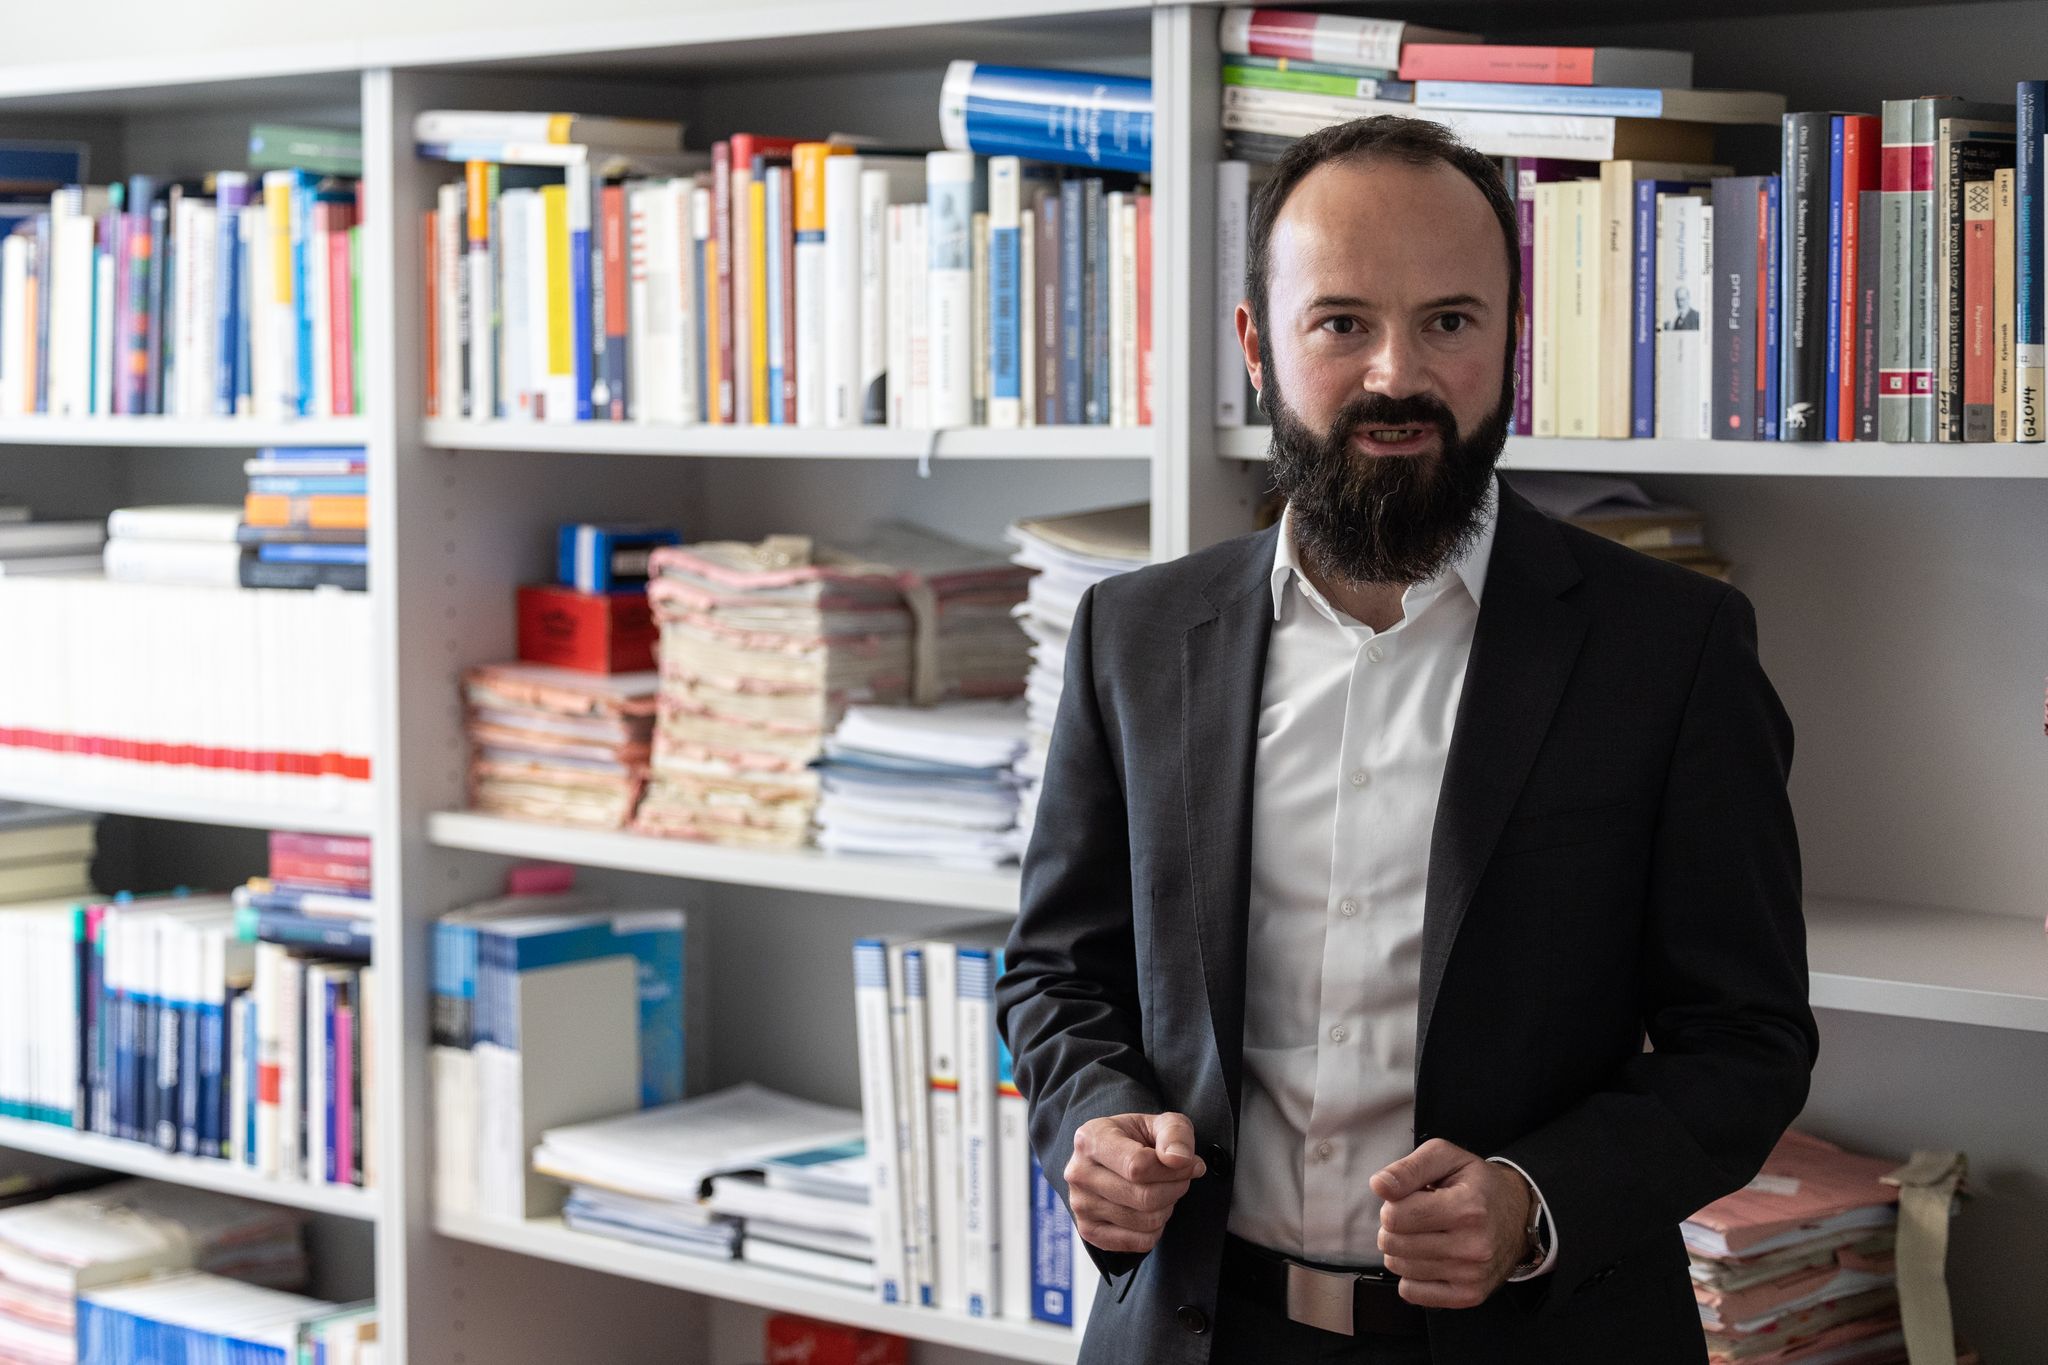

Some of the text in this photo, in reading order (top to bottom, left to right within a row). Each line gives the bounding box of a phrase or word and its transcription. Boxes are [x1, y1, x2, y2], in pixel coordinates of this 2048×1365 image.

[1799, 126, 1809, 145] Otto
[1796, 153, 1809, 192] Kernberg
[1701, 217, 1713, 276] Sigmund Freud
[2021, 195, 2033, 253] Suggestion
[1675, 245, 1687, 281] Sigmund
[1793, 199, 1808, 348] Schwere Persönlichkeitsstörungen
[1949, 147, 1961, 395] Jean Piaget Psychology and Epistemology
[2022, 255, 2032, 273] and
[1729, 274, 1741, 330] Freud
[1729, 335, 1742, 363] Gay
[1974, 305, 1984, 357] Psychologie
[2001, 323, 2009, 361] Kybernetik
[2024, 386, 2037, 438] G2044
